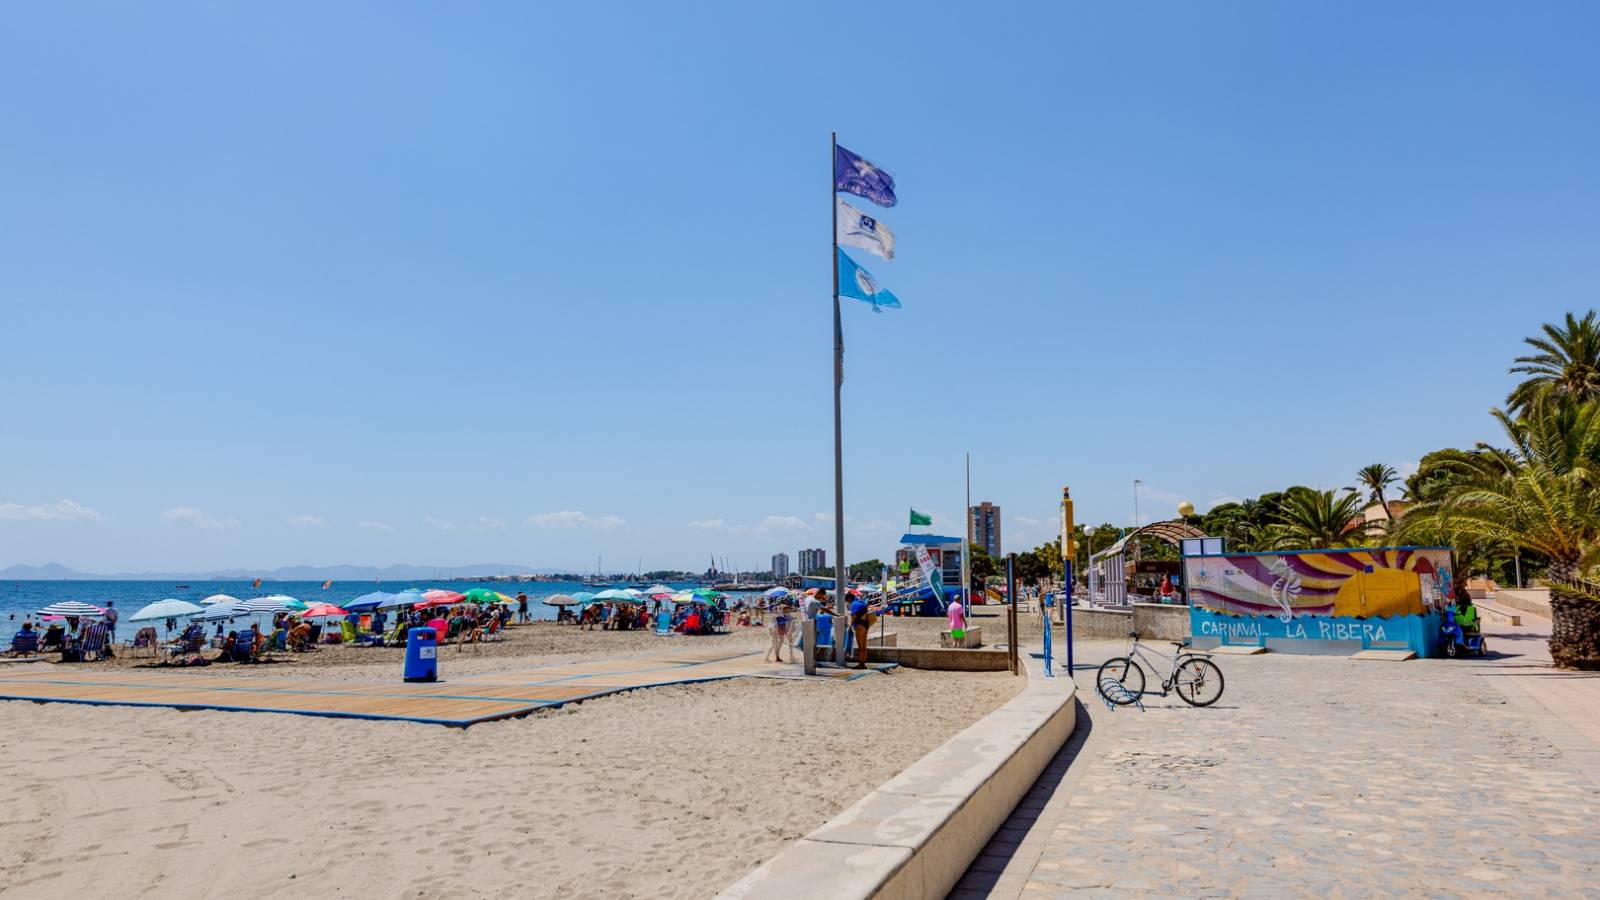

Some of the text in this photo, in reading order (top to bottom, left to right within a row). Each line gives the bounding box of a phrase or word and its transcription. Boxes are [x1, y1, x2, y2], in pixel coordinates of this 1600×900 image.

[1201, 621, 1386, 642] CARNAVAL LA RIBERA
